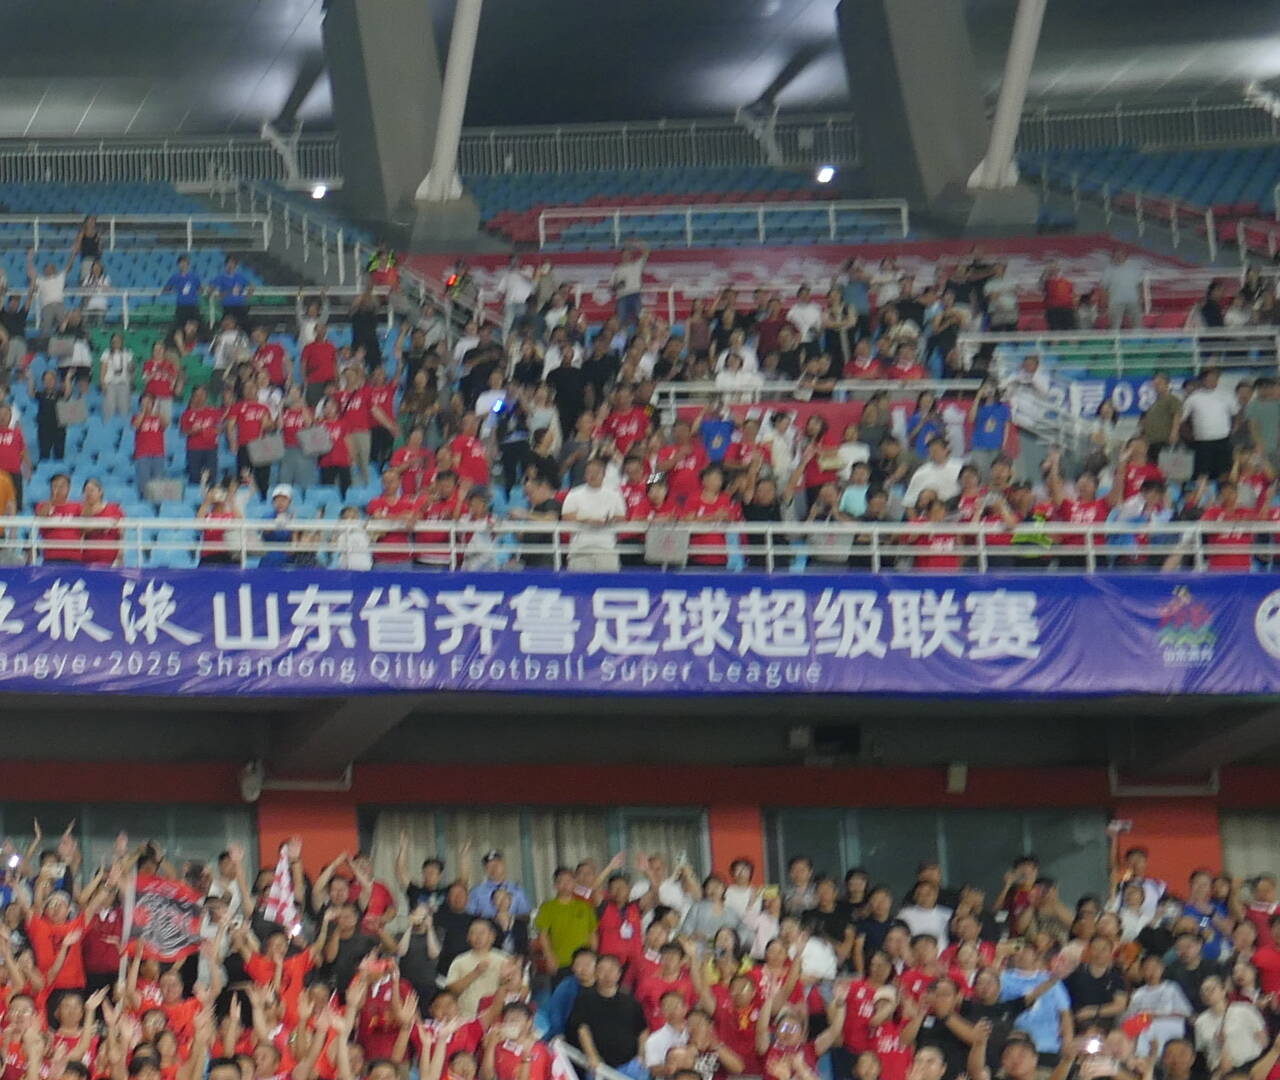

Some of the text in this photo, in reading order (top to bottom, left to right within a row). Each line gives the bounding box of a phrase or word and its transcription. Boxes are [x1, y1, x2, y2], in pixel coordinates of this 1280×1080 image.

[214, 584, 1040, 661] 山东省齐鲁足球超级联赛
[196, 650, 356, 682] Shandong
[369, 652, 437, 683] Qilu
[450, 655, 585, 684] Football
[600, 658, 692, 686] Super
[708, 660, 822, 688] League
